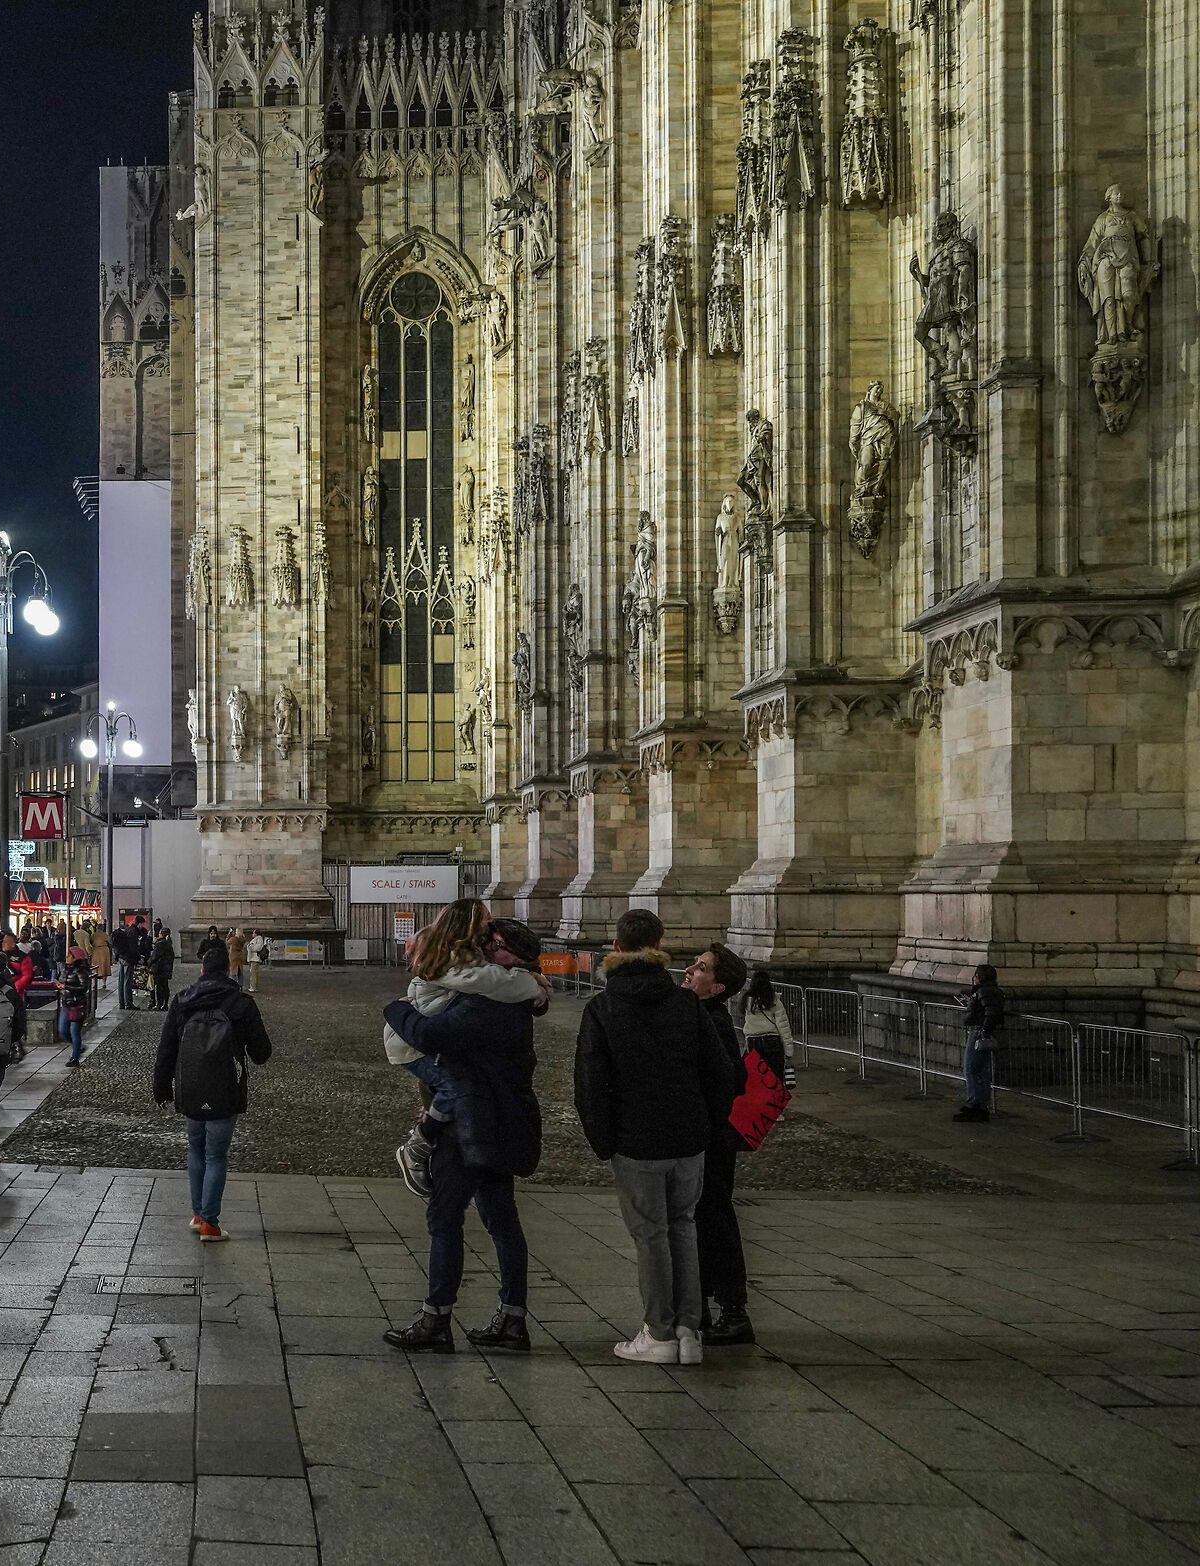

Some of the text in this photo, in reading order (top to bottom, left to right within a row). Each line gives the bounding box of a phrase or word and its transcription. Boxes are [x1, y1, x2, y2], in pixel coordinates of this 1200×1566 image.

[24, 802, 62, 831] M
[371, 879, 400, 889] SCALE
[408, 879, 436, 889] STAIRS
